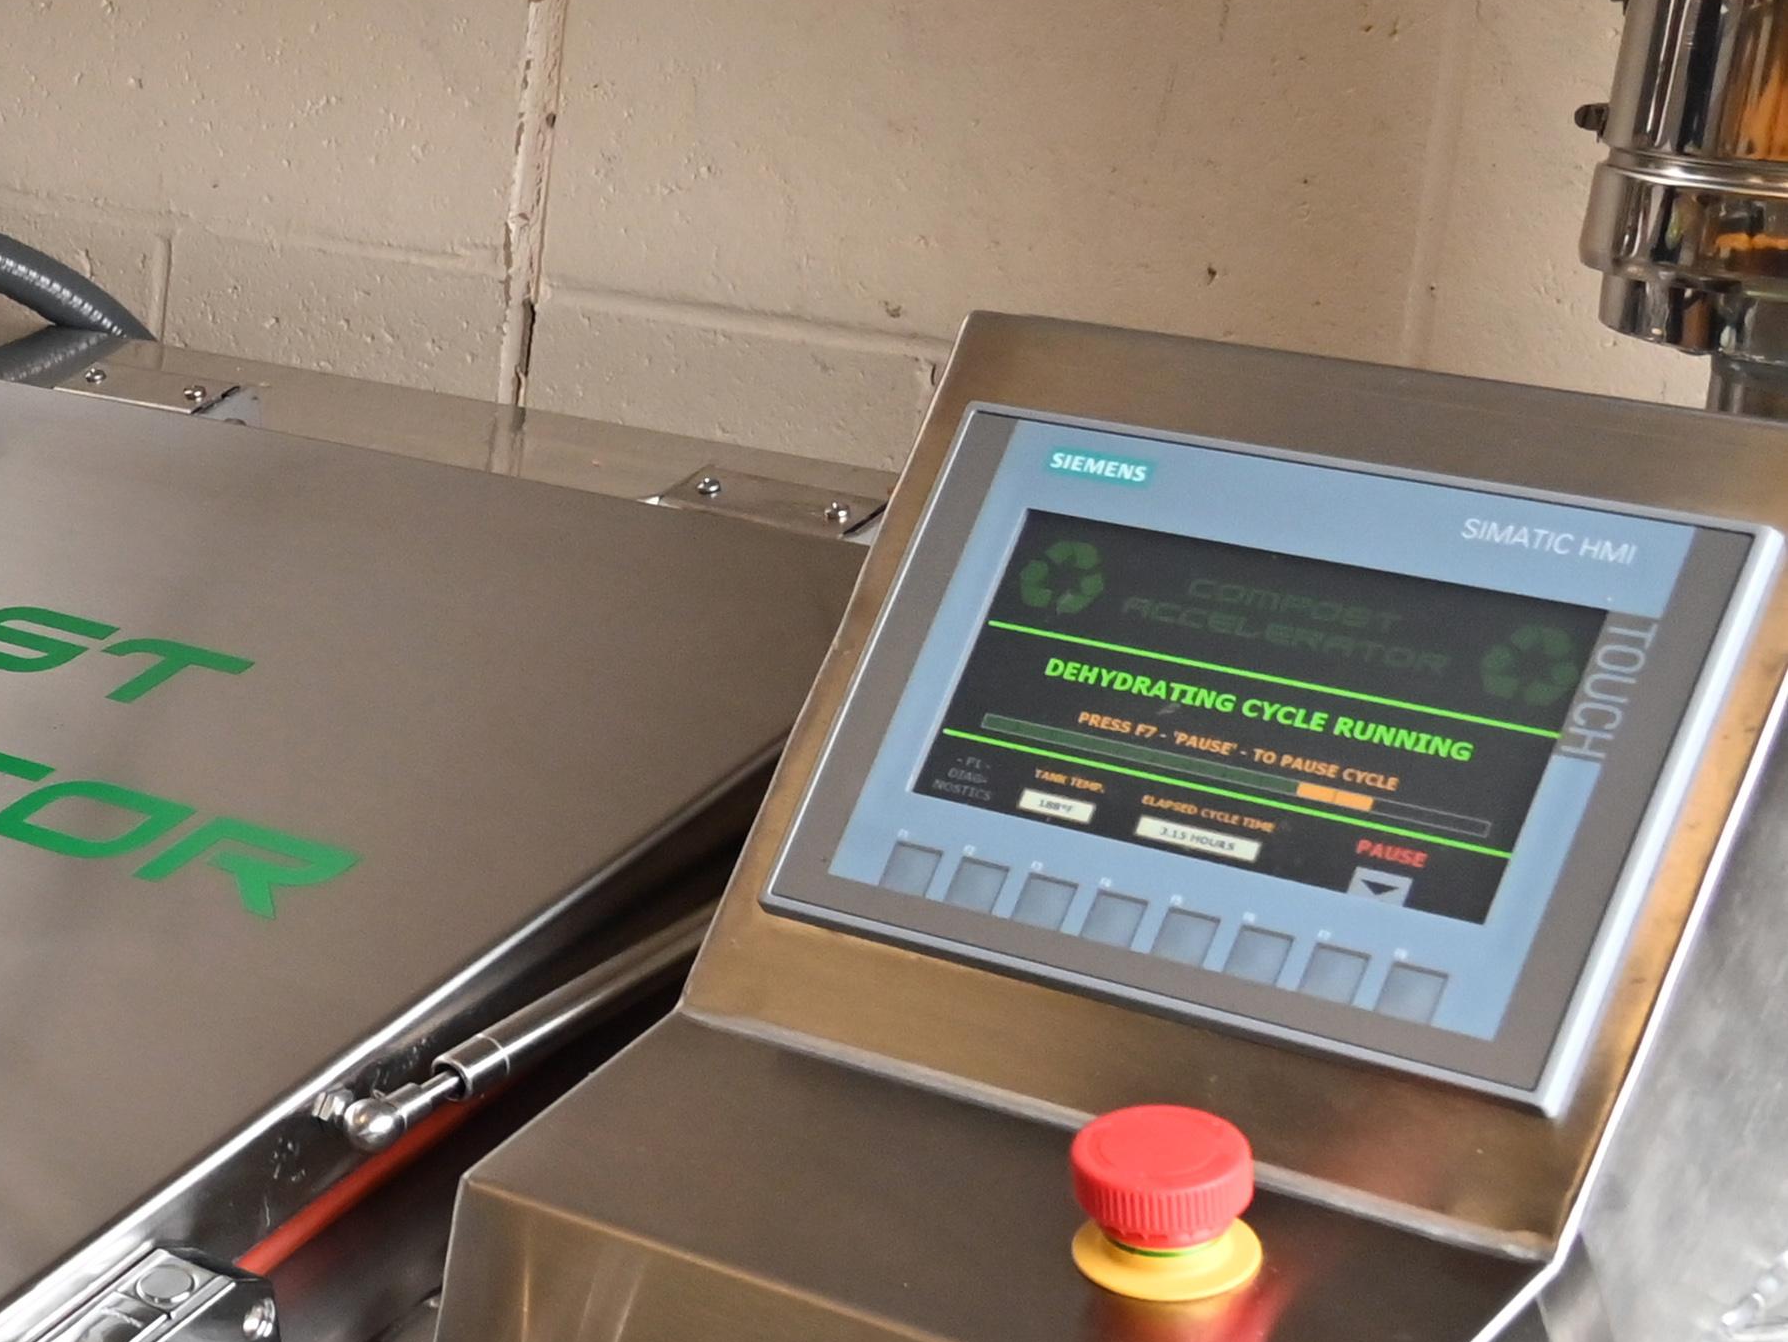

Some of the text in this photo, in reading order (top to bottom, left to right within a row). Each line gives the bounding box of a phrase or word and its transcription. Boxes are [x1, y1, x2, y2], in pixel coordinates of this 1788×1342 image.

[1049, 452, 1148, 482] SIEMENS
[1461, 518, 1638, 565] SIMATIC HMI
[1188, 578, 1403, 632] COMPOST
[1123, 596, 1452, 674] ACCELERATOR
[1044, 657, 1475, 762] DEHYDRATING CYCLE RUNNING
[1560, 623, 1659, 759] TOUCH
[1078, 711, 1132, 734] PRESS
[1135, 724, 1158, 739] F7
[1173, 730, 1238, 757] 'PAUSE'
[1253, 748, 1278, 765] TO
[1280, 754, 1339, 779] PAUSE
[1342, 768, 1400, 792] CYCLE
[932, 778, 992, 802] NOSTICS
[1035, 768, 1069, 785] TANK
[1141, 794, 1276, 833] ELAPSED CYCLE TIME
[1190, 833, 1236, 852] HOURS
[1355, 838, 1429, 868] PAUSE
